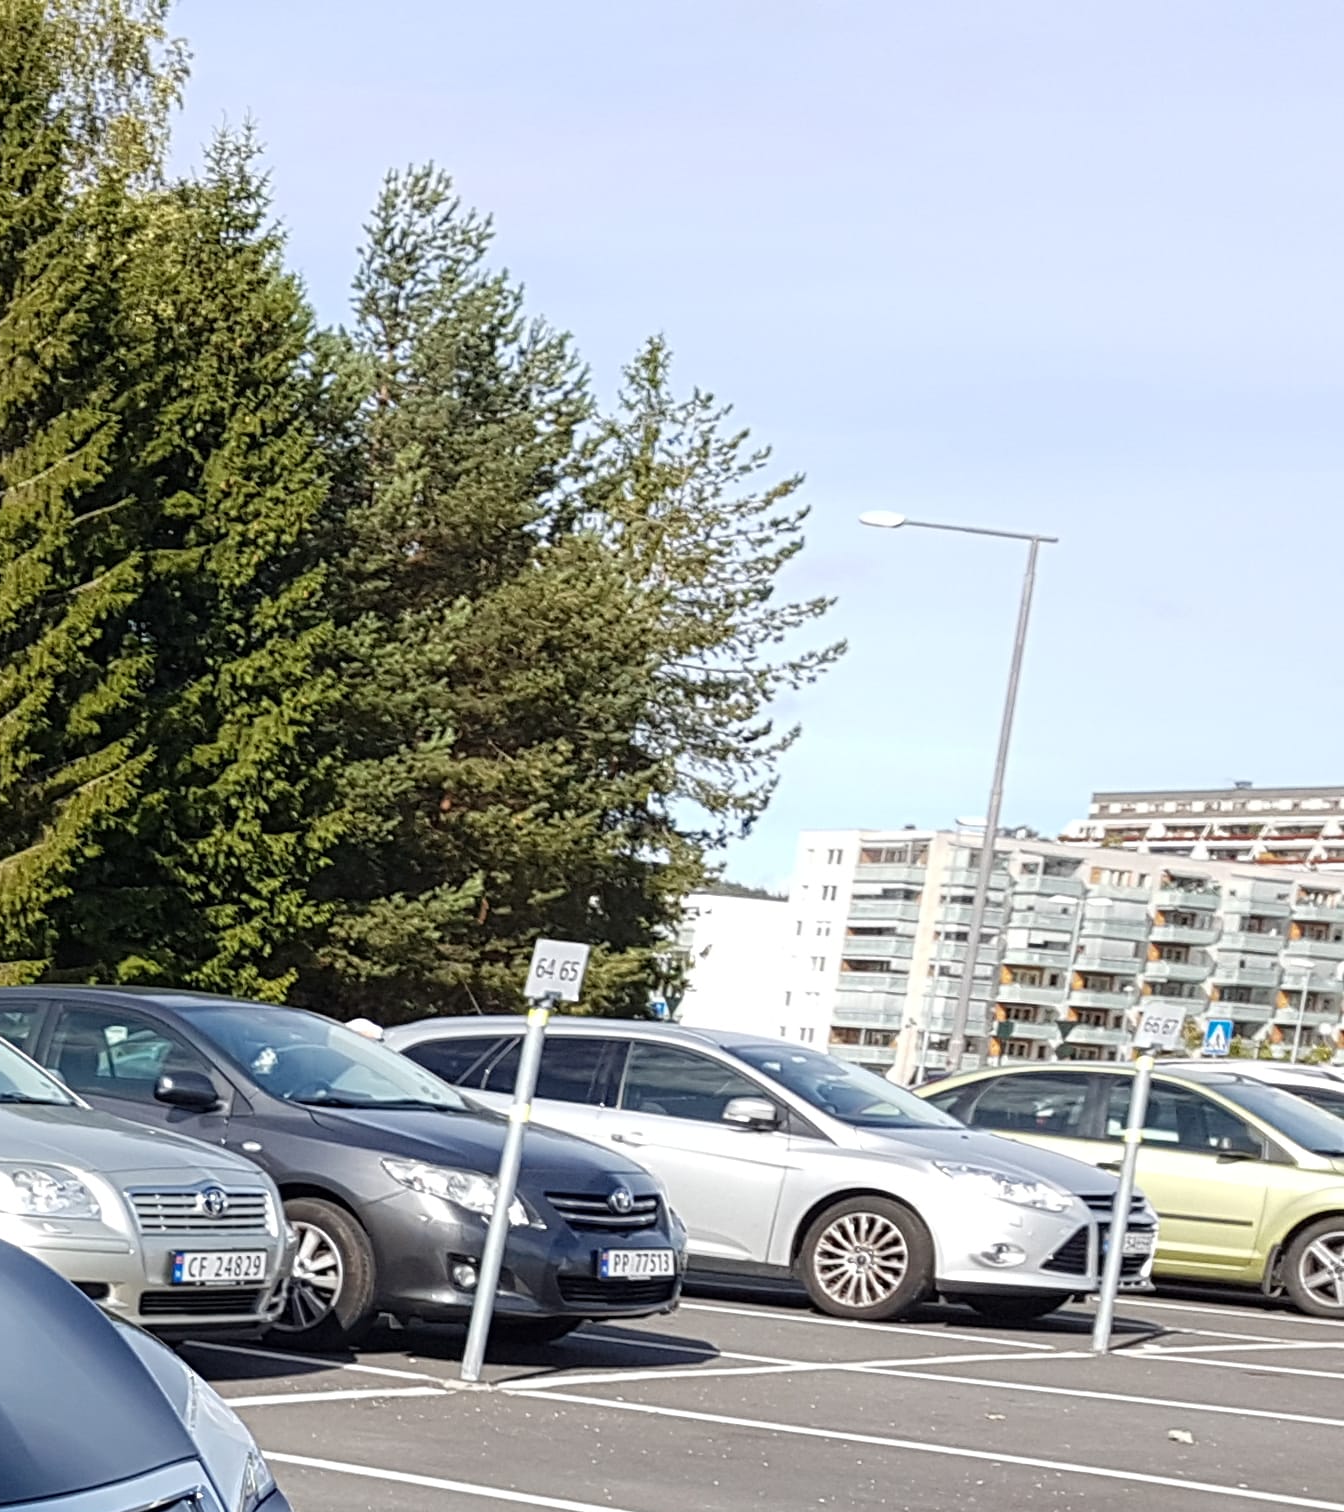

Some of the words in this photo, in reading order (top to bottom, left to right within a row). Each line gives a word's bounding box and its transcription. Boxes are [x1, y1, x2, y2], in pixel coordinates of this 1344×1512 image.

[535, 958, 556, 979] 64
[559, 961, 580, 981] 65
[188, 1256, 208, 1277] CF
[214, 1255, 262, 1277] 24829
[613, 1253, 630, 1273] PP
[635, 1253, 670, 1273] 77513
